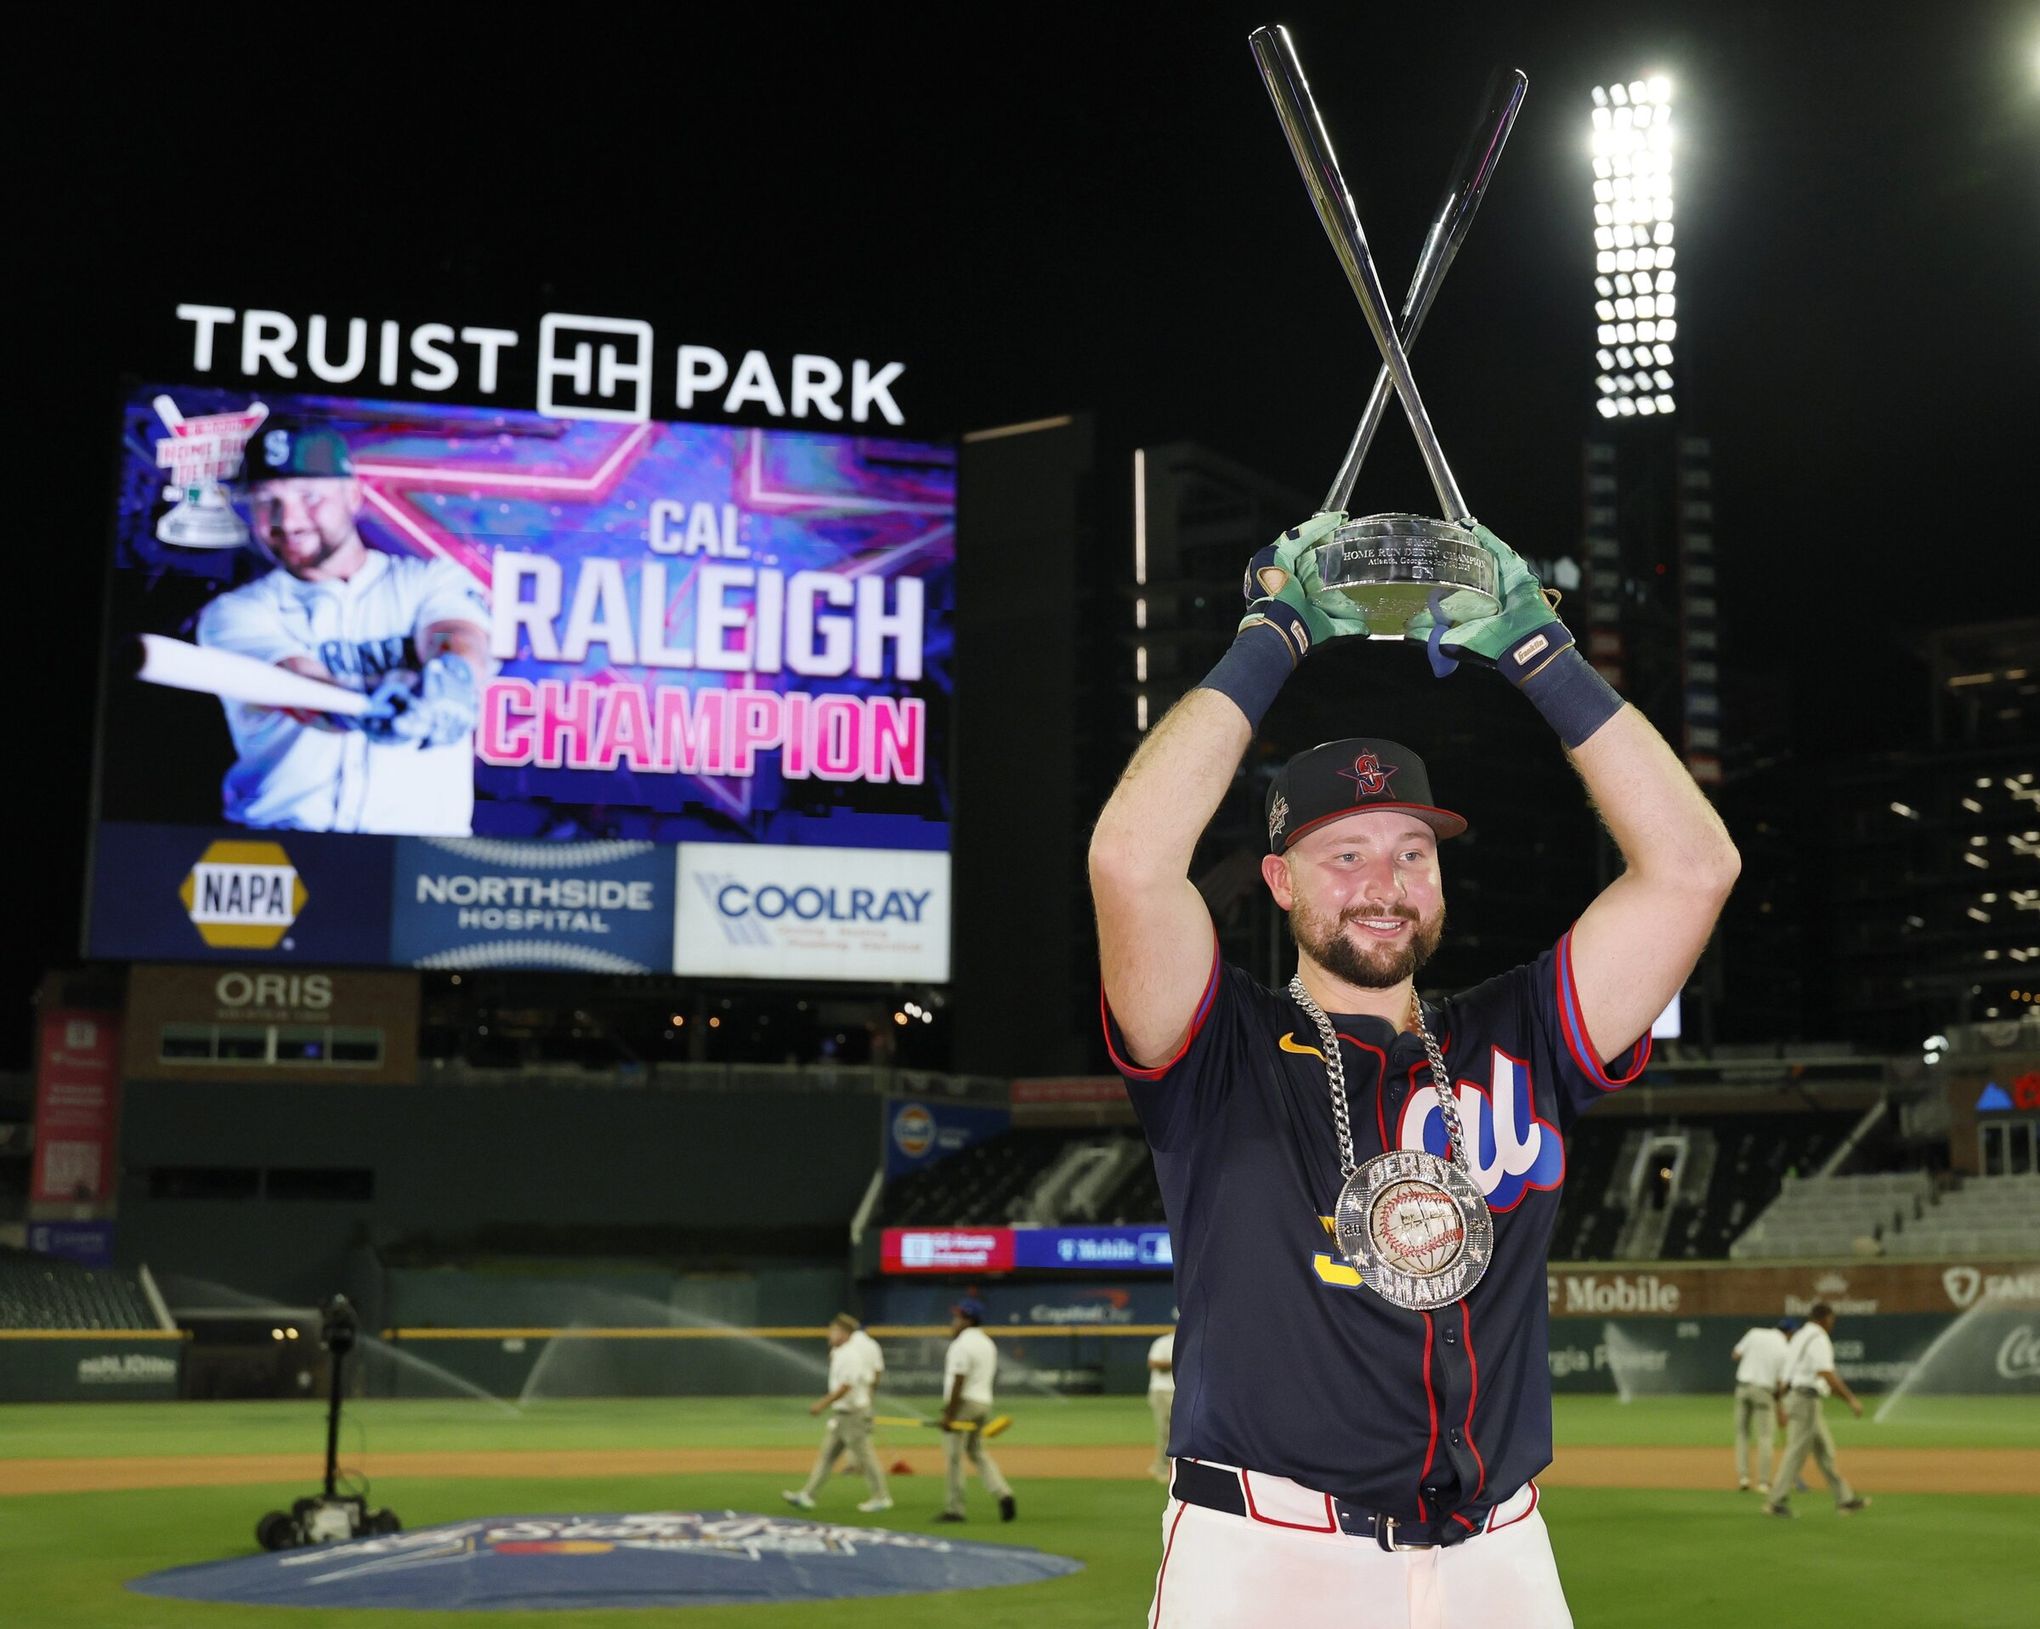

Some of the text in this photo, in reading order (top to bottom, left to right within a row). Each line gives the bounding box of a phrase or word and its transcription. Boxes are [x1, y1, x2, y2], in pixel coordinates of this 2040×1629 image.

[176, 303, 905, 426] TRUIST PARK
[649, 499, 752, 558] CAL
[1343, 549, 1376, 561] HOME
[1378, 547, 1401, 558] RUN
[490, 550, 925, 682] RALEIGH
[475, 676, 926, 786] CHAMPION
[1355, 754, 1385, 795] S
[202, 873, 286, 916] NAPA
[416, 875, 654, 911] NORTHSIDE
[717, 883, 933, 923] COOLRAY
[458, 907, 611, 934] HOSPITAL
[216, 971, 334, 1009] ORIS
[1368, 1153, 1453, 1190] DERBY
[1376, 1261, 1468, 1303] CHAMP
[1565, 1275, 1681, 1313] Mobile
